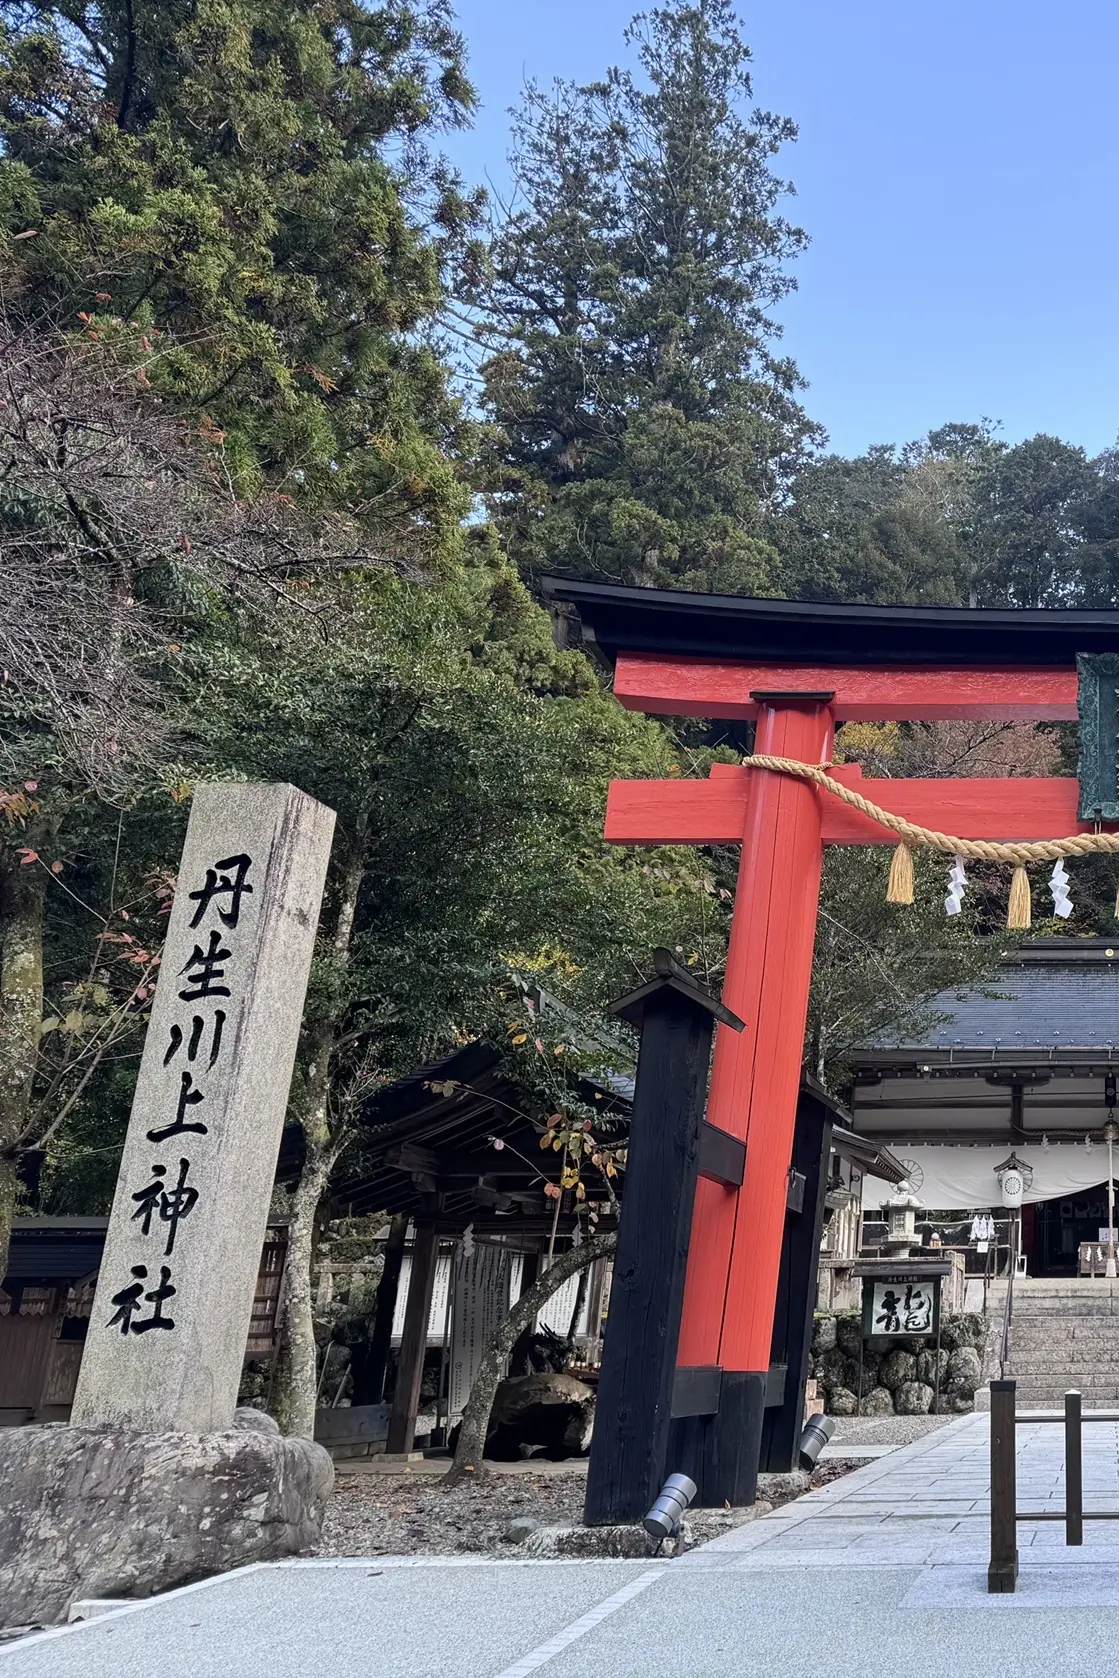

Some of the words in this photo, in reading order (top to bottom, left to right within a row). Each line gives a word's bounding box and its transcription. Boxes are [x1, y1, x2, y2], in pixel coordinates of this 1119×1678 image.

[105, 853, 253, 1336] 丹生川上神社
[875, 1284, 932, 1333] 龍
